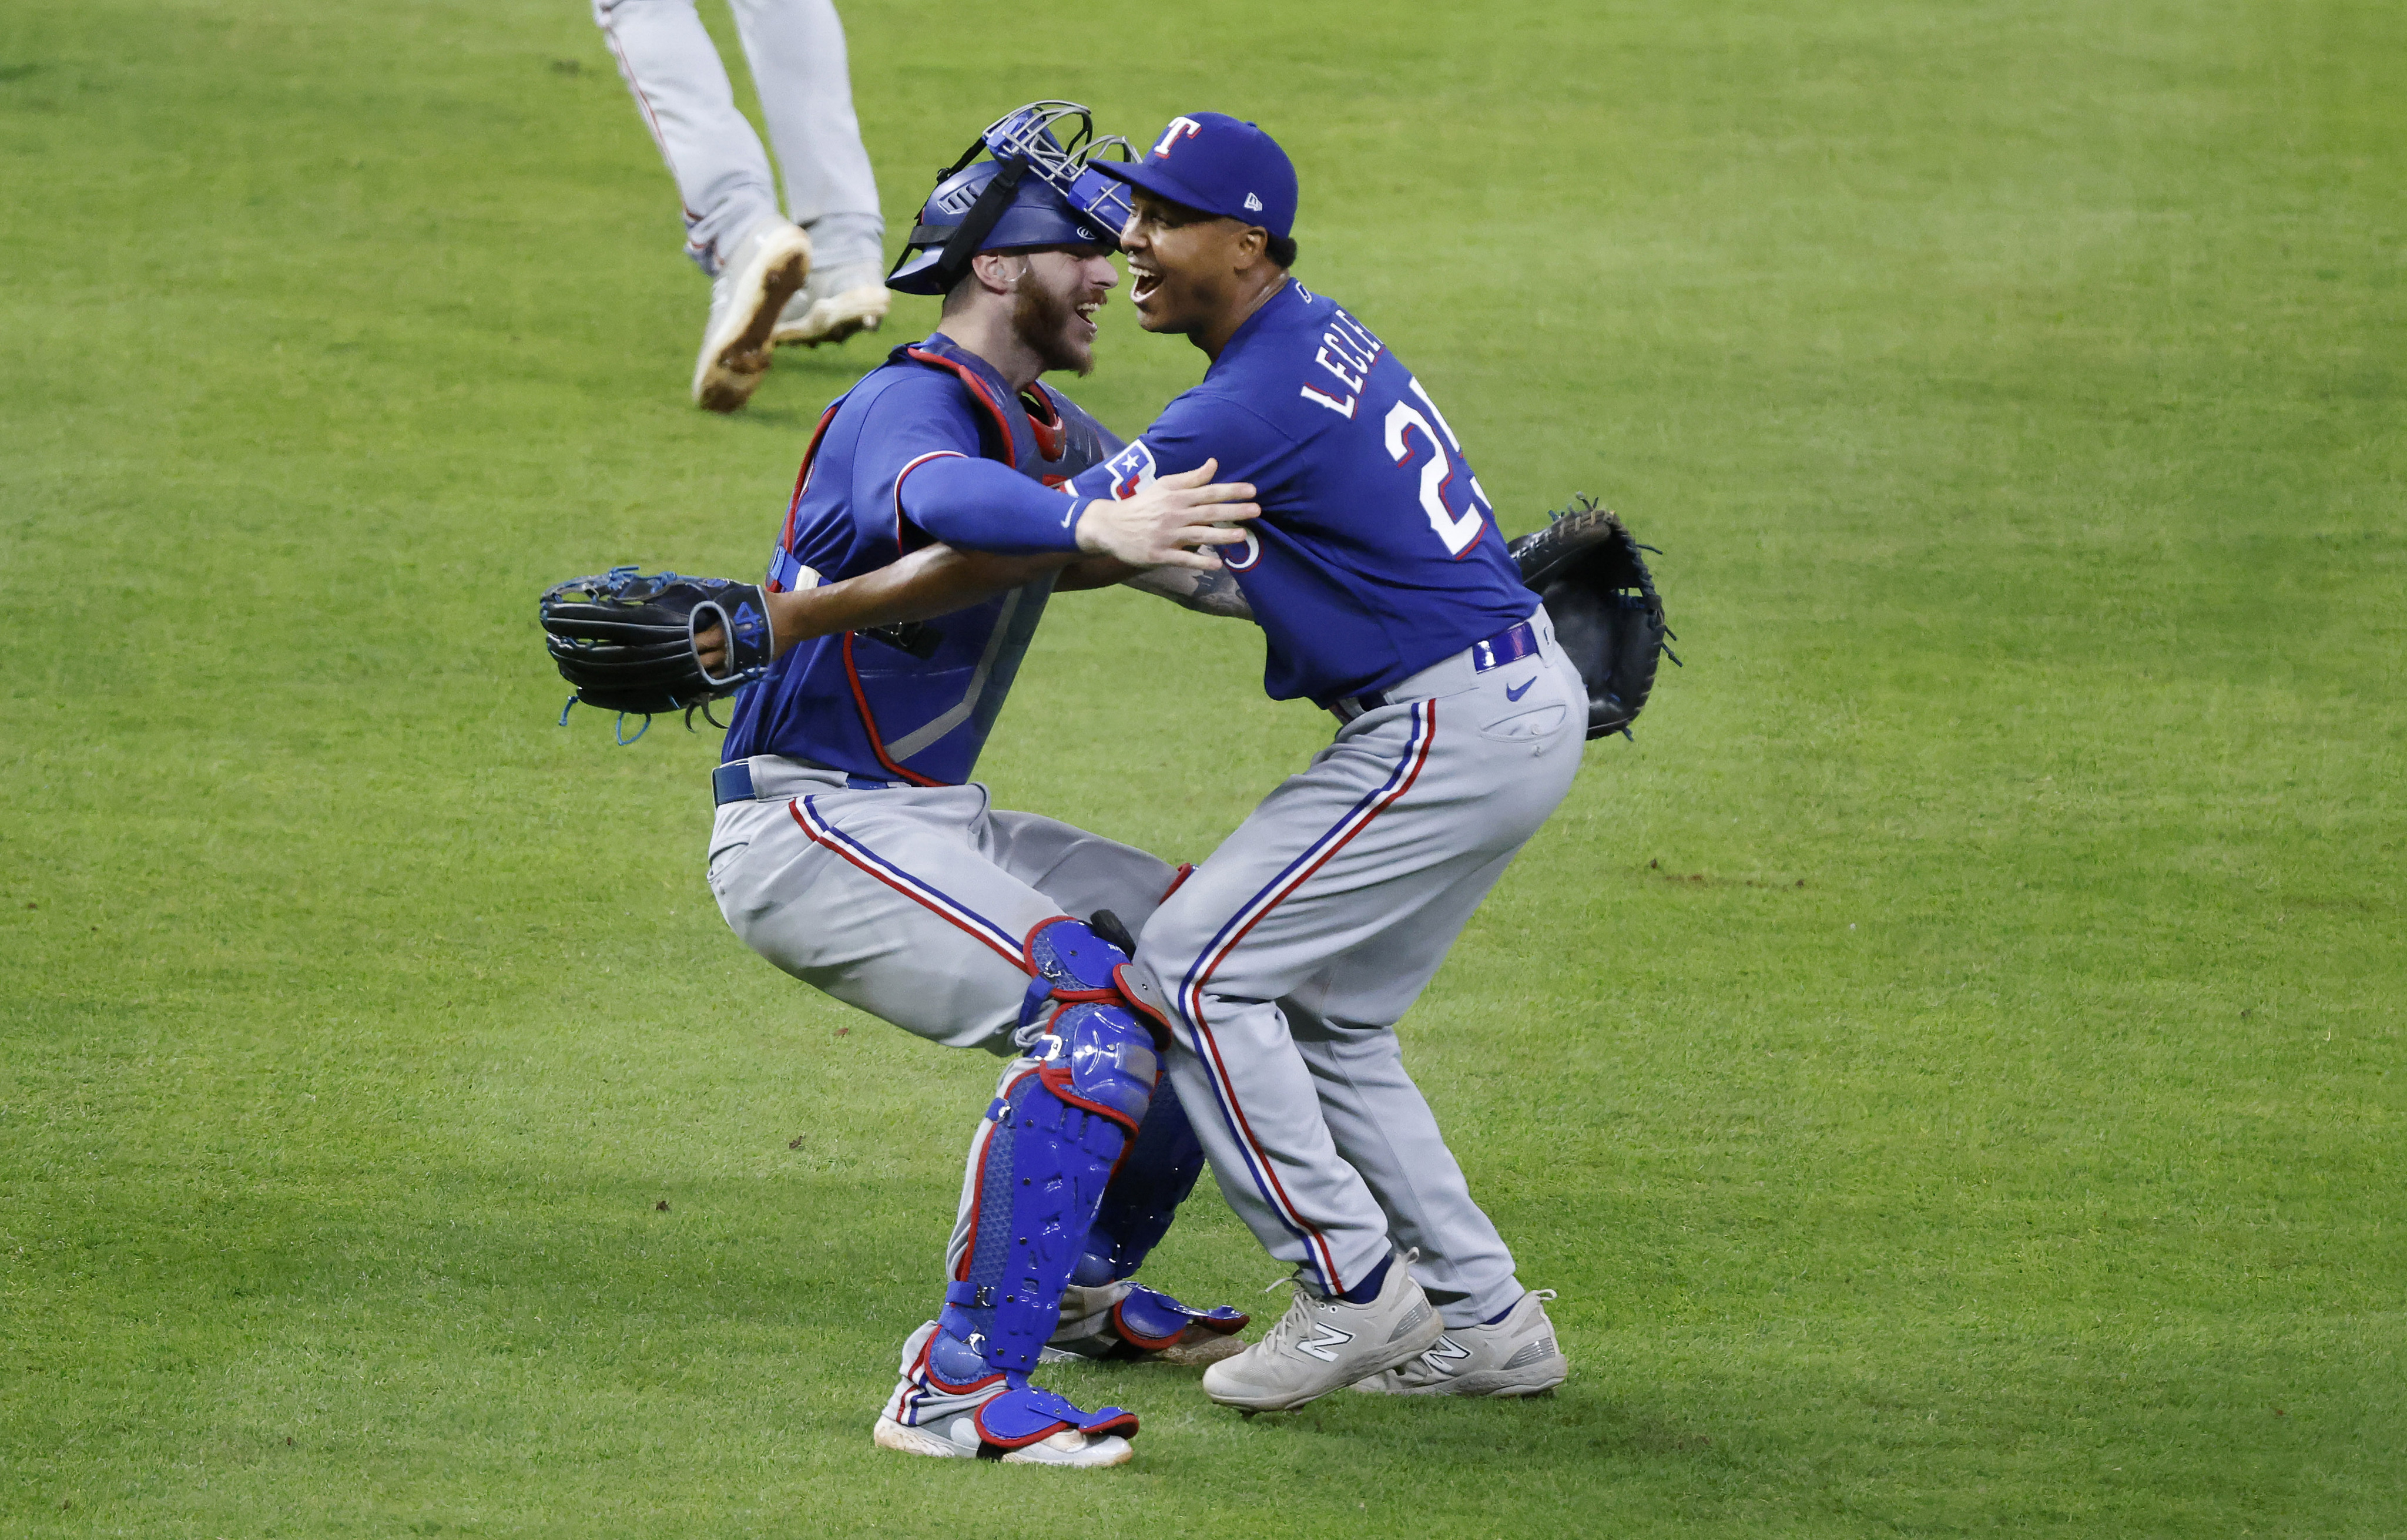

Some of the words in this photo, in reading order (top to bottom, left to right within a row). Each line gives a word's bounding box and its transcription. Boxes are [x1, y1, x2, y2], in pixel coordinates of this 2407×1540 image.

[1154, 116, 1202, 159] T
[1300, 308, 1386, 421] LECLE
[1295, 1322, 1356, 1362] N
